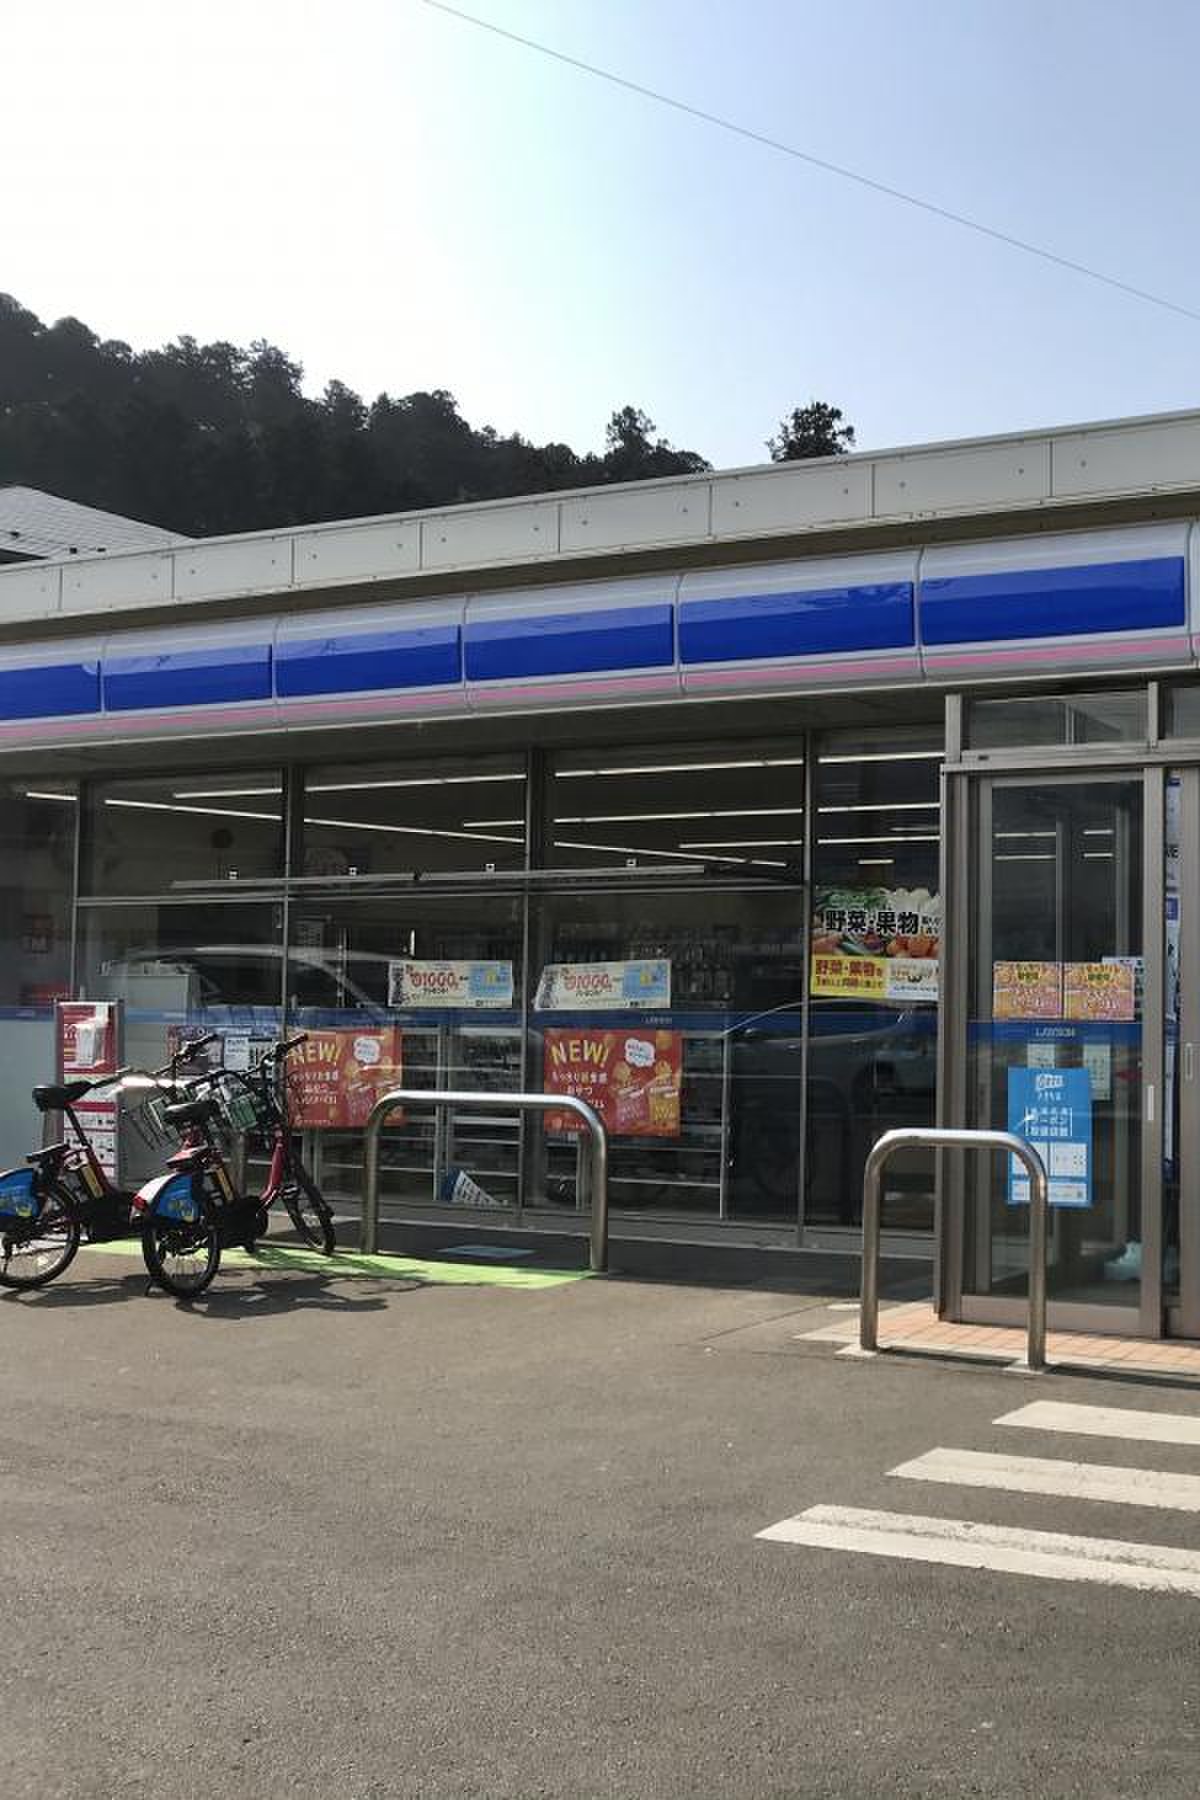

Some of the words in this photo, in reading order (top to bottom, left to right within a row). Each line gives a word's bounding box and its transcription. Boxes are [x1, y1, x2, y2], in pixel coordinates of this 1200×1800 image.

[825, 910, 919, 935] 野菜・果物
[289, 1041, 342, 1066] NEW!
[550, 1039, 609, 1068] NEW!
